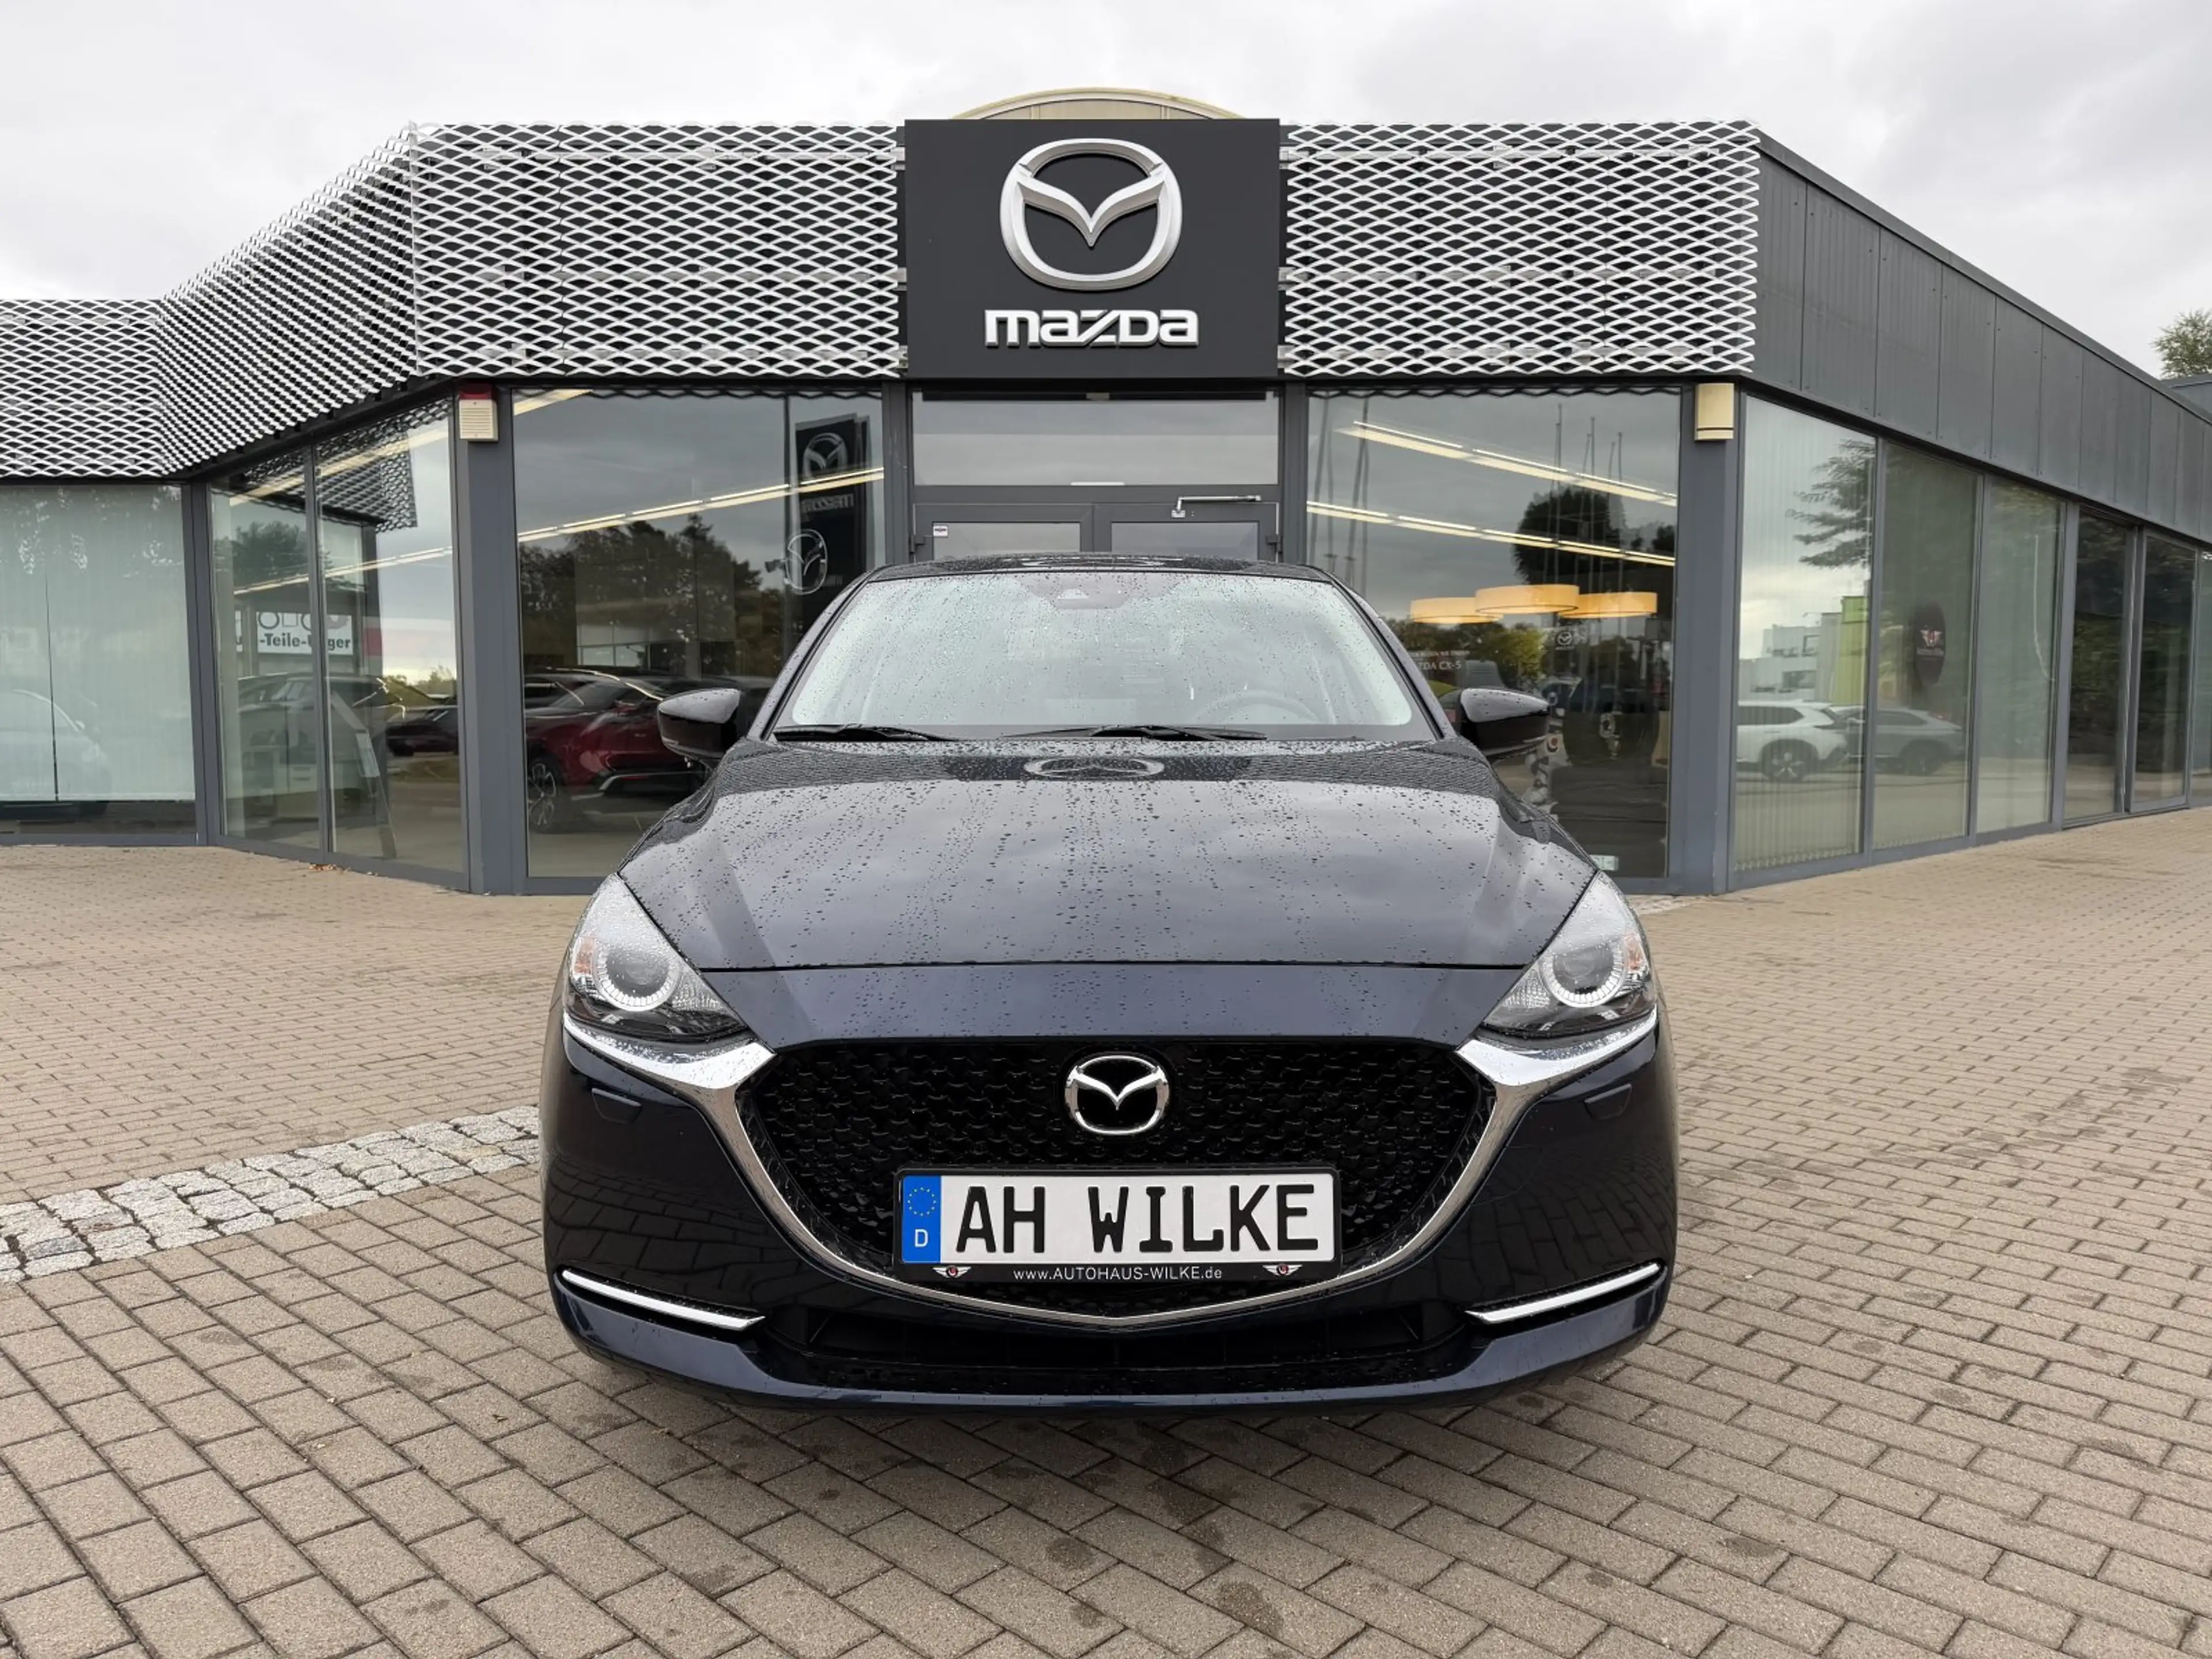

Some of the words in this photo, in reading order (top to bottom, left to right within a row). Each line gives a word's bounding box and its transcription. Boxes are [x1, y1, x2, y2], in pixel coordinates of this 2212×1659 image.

[956, 1186, 1046, 1253] AH
[1088, 1184, 1318, 1253] WILKE
[915, 1229, 928, 1247] D
[1013, 1267, 1222, 1281] www.AUTOHAUS-WILKE.de
